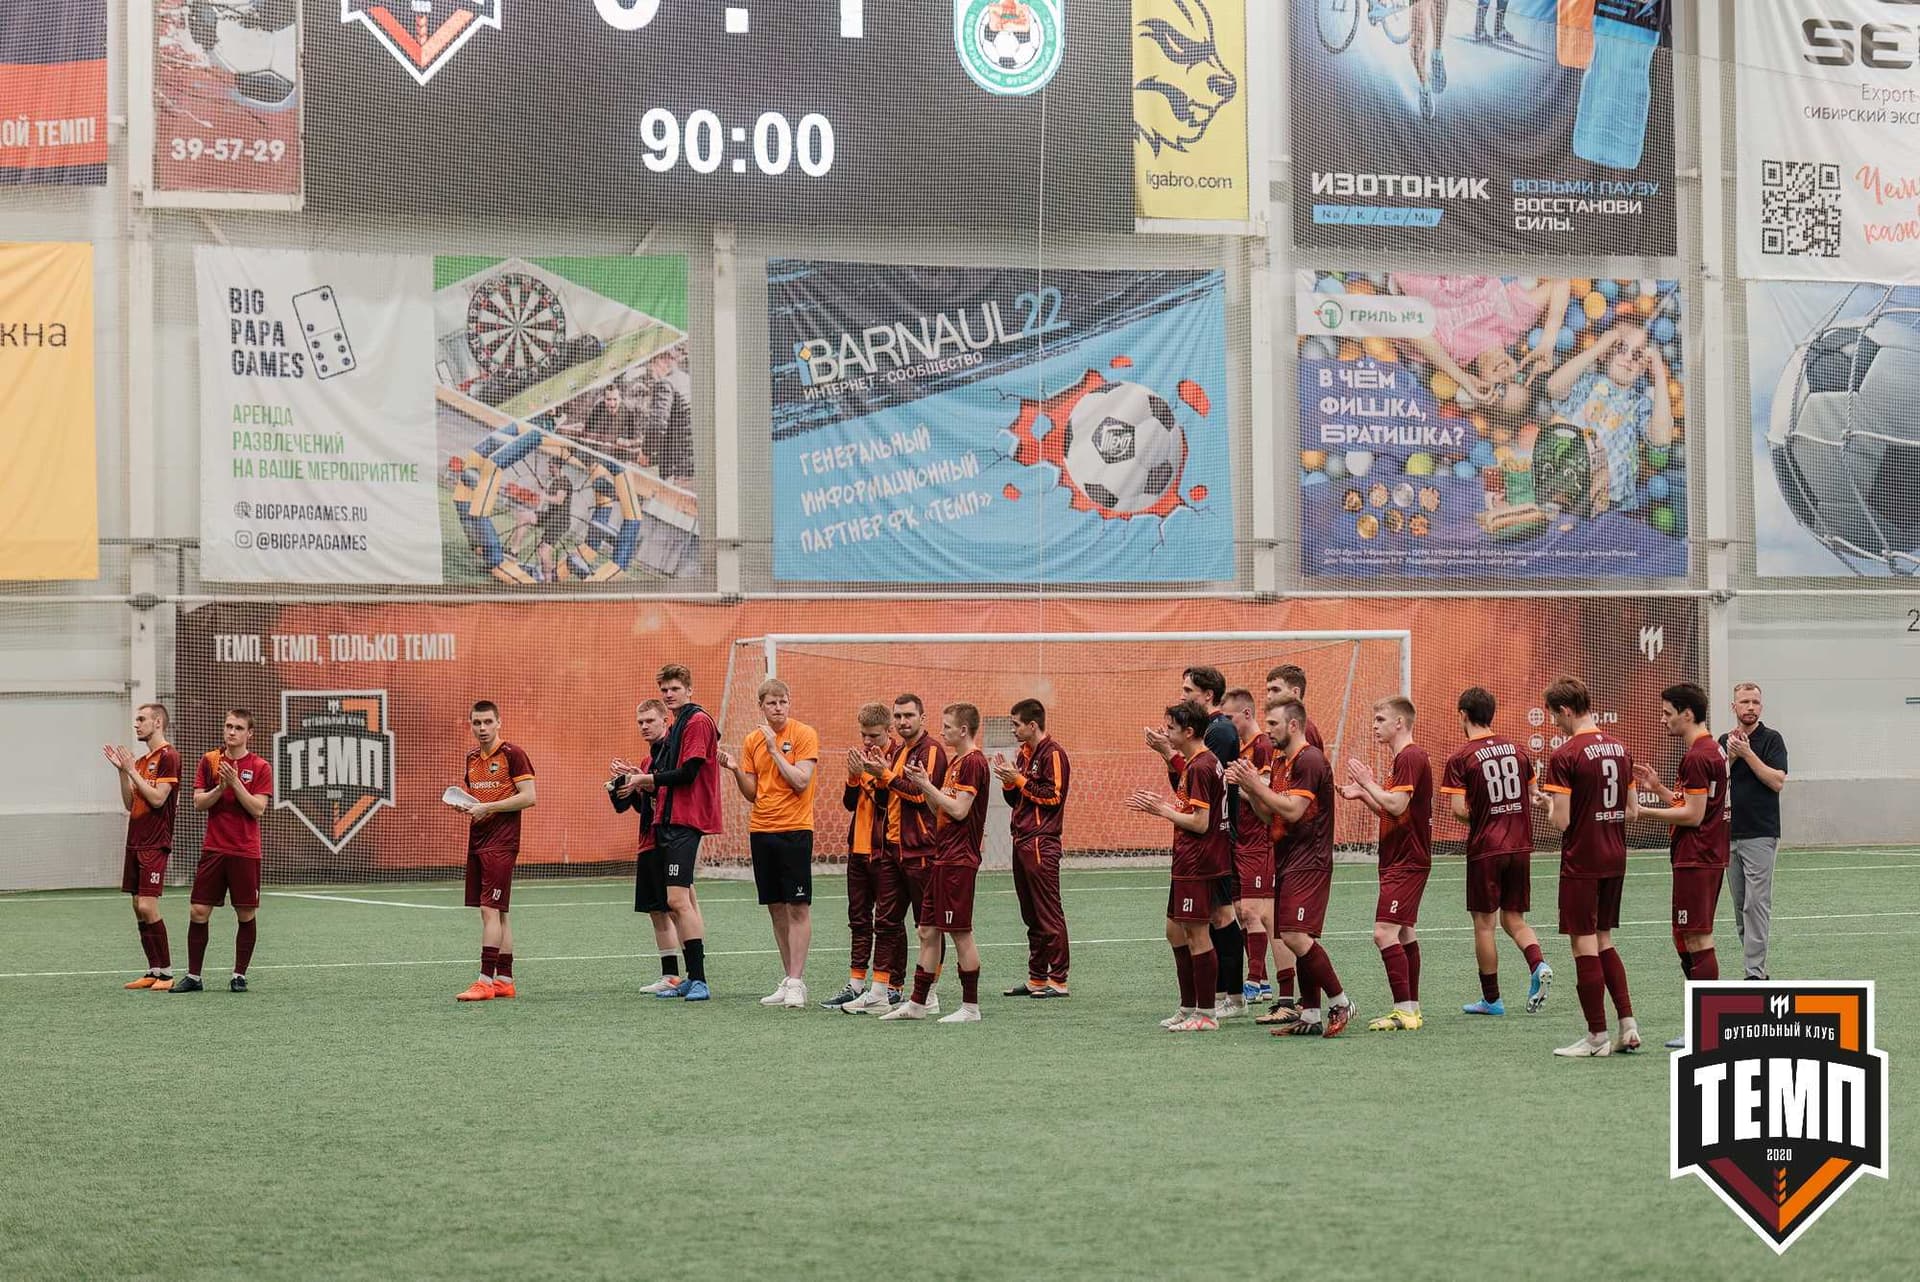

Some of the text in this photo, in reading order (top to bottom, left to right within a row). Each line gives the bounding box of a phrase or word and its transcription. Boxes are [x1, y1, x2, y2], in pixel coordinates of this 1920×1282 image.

[1802, 18, 1920, 69] SE
[1803, 106, 1886, 122] СИБИРСКИЙ
[35, 116, 97, 147] ТЕМП!
[639, 107, 835, 178] 90:00
[171, 138, 286, 162] 39-57-29
[1145, 170, 1233, 190] ligabro.com
[1311, 172, 1491, 201] ИЗОТОНИК
[1512, 178, 1593, 194] ВОЗЬМИ
[1513, 198, 1643, 215] ВОССТАНОВИ
[1514, 216, 1575, 231] СИЛЫ.
[228, 287, 265, 315] BIG
[1350, 309, 1398, 323] ГРИЛЬ
[230, 319, 287, 347] PAPA
[232, 350, 305, 379] GAMES
[1320, 361, 1396, 389] В ЧЁМ
[233, 405, 294, 427] АРЕНДА
[1320, 396, 1427, 422] ФИШКА,
[233, 431, 345, 454] РАЗВЛЕЧЕНИЙ
[1320, 424, 1465, 447] БРАТИШКА?
[800, 423, 932, 476] ГЕНЕРАЛЬНЫЙ
[233, 459, 419, 483] НА ВАШЕ МЕРОПРИЯТИЕ
[801, 450, 980, 516] ИНФОРМАЦИОННЫЙ
[255, 503, 368, 522] BIGPAPAGAMES.RU
[801, 491, 993, 553] ПАРТНЕР ФК «ТЕМП»
[256, 532, 367, 551] @BIGPAPAGAMES
[214, 634, 456, 665] ТЕМП, ТЕМП, ТОЛЬКО ТЕМП!
[286, 736, 384, 791] ТЕМП
[1482, 755, 1521, 803] 88
[1602, 759, 1618, 808] 3
[1490, 802, 1522, 815] SEUS
[1595, 810, 1625, 821] SEUS
[150, 872, 160, 884] 33
[668, 864, 679, 876] 99
[1255, 876, 1262, 888] 6
[492, 888, 502, 901] 19
[1182, 898, 1193, 912] 21
[945, 911, 954, 925] 17
[1297, 907, 1305, 921] 8
[1389, 900, 1398, 914] 2
